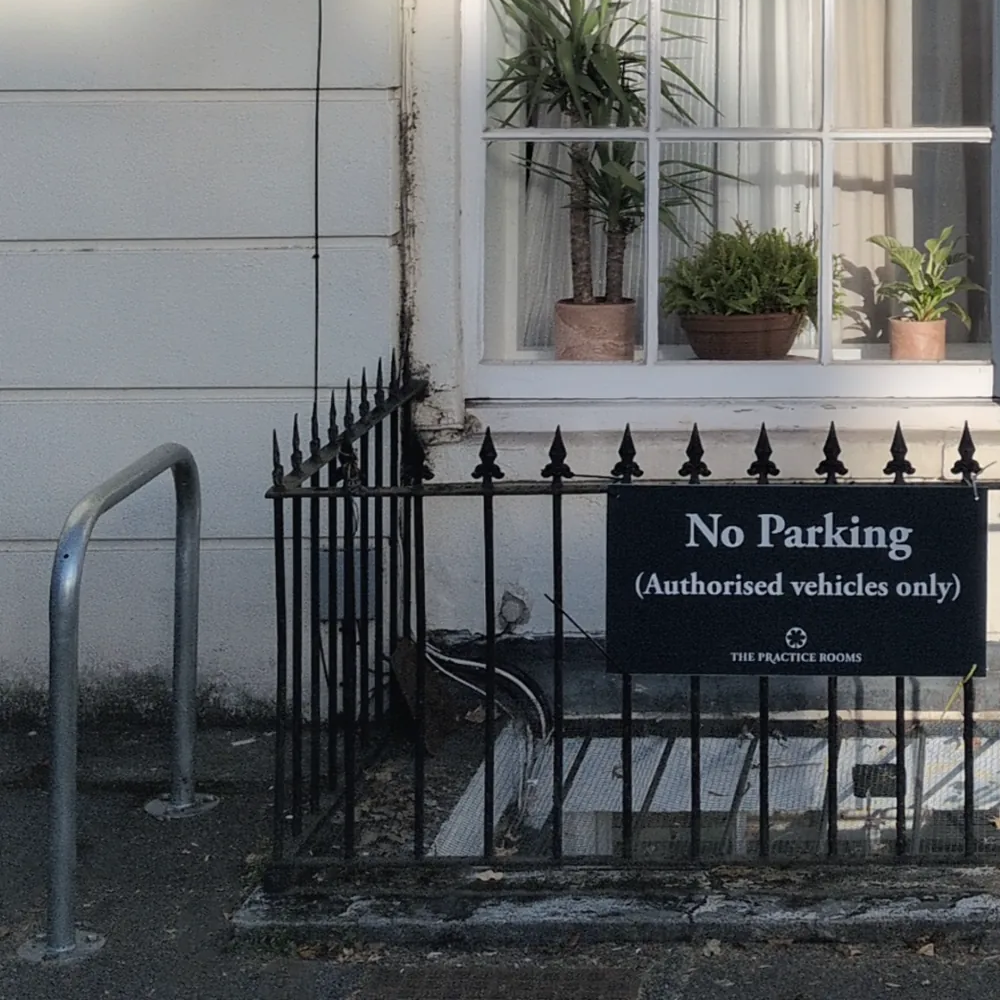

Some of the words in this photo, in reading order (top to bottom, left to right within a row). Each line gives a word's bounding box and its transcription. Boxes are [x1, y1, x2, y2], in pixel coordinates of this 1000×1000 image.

[685, 513, 744, 548] No
[757, 511, 913, 561] Parking
[634, 571, 784, 600] (Authorised
[790, 572, 889, 597] vehicles
[896, 573, 962, 604] only)
[730, 651, 756, 663] THE
[758, 651, 817, 665] PRACTICE
[818, 651, 863, 663] ROOMS
